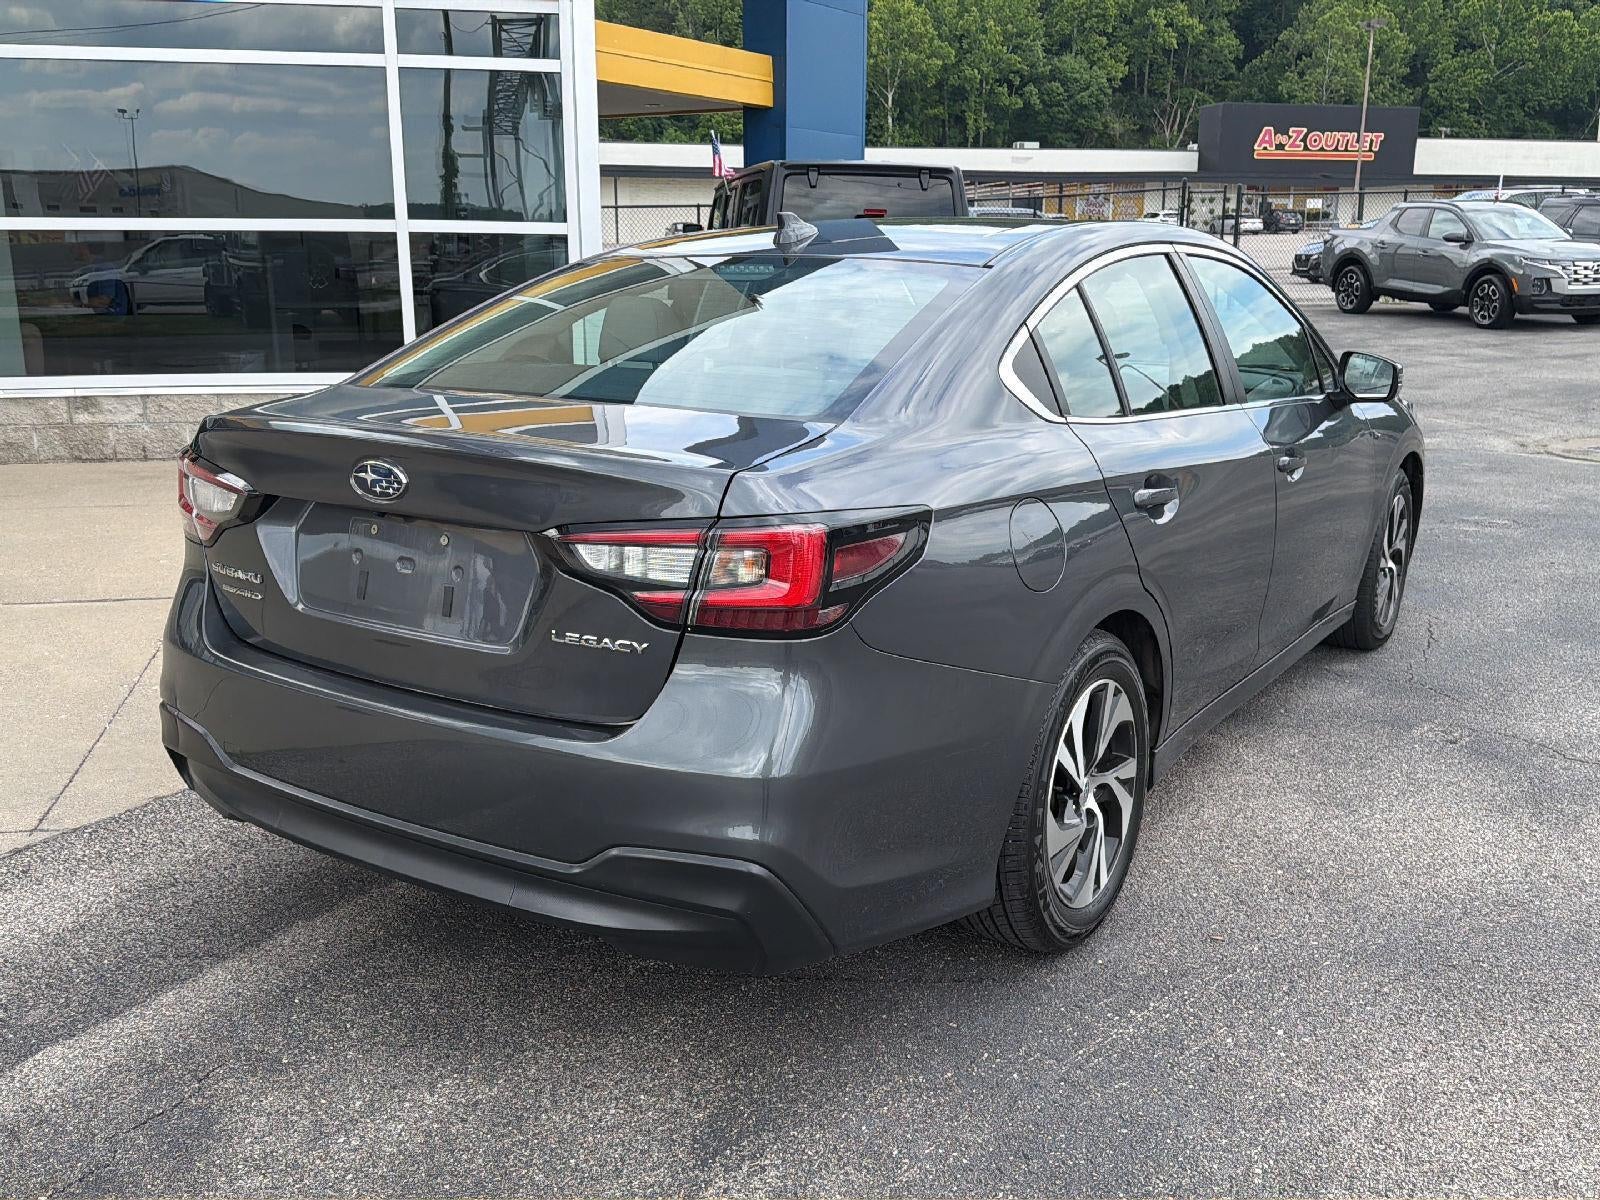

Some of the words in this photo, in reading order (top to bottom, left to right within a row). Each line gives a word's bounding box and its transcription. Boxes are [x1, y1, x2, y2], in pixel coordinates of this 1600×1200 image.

[1307, 131, 1384, 151] OUTLET
[211, 562, 263, 584] SUBARU
[551, 629, 650, 654] LEGACY
